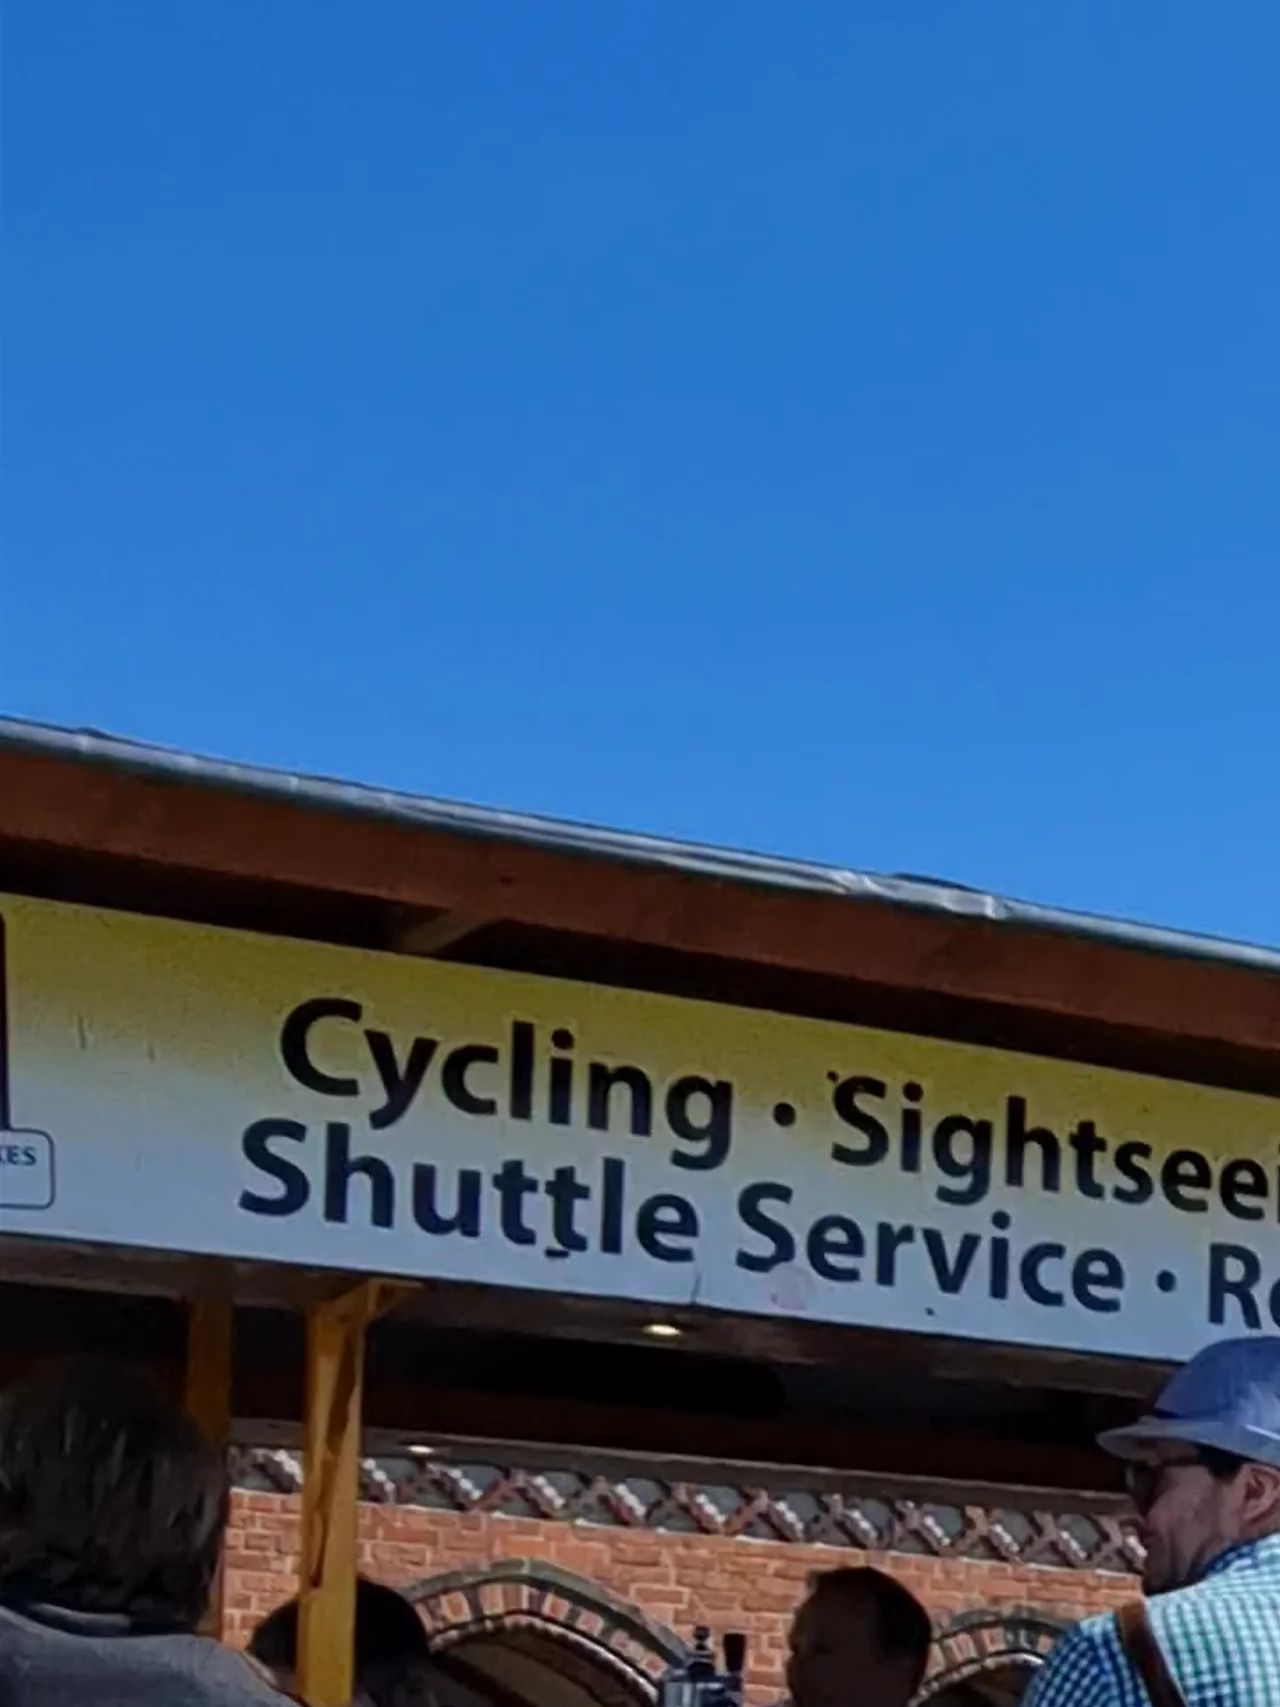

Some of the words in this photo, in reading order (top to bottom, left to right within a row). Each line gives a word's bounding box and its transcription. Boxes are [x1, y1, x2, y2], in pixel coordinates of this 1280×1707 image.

[280, 997, 733, 1170] Cycling
[238, 1119, 700, 1262] Shuttle
[735, 1182, 1124, 1313] Service
